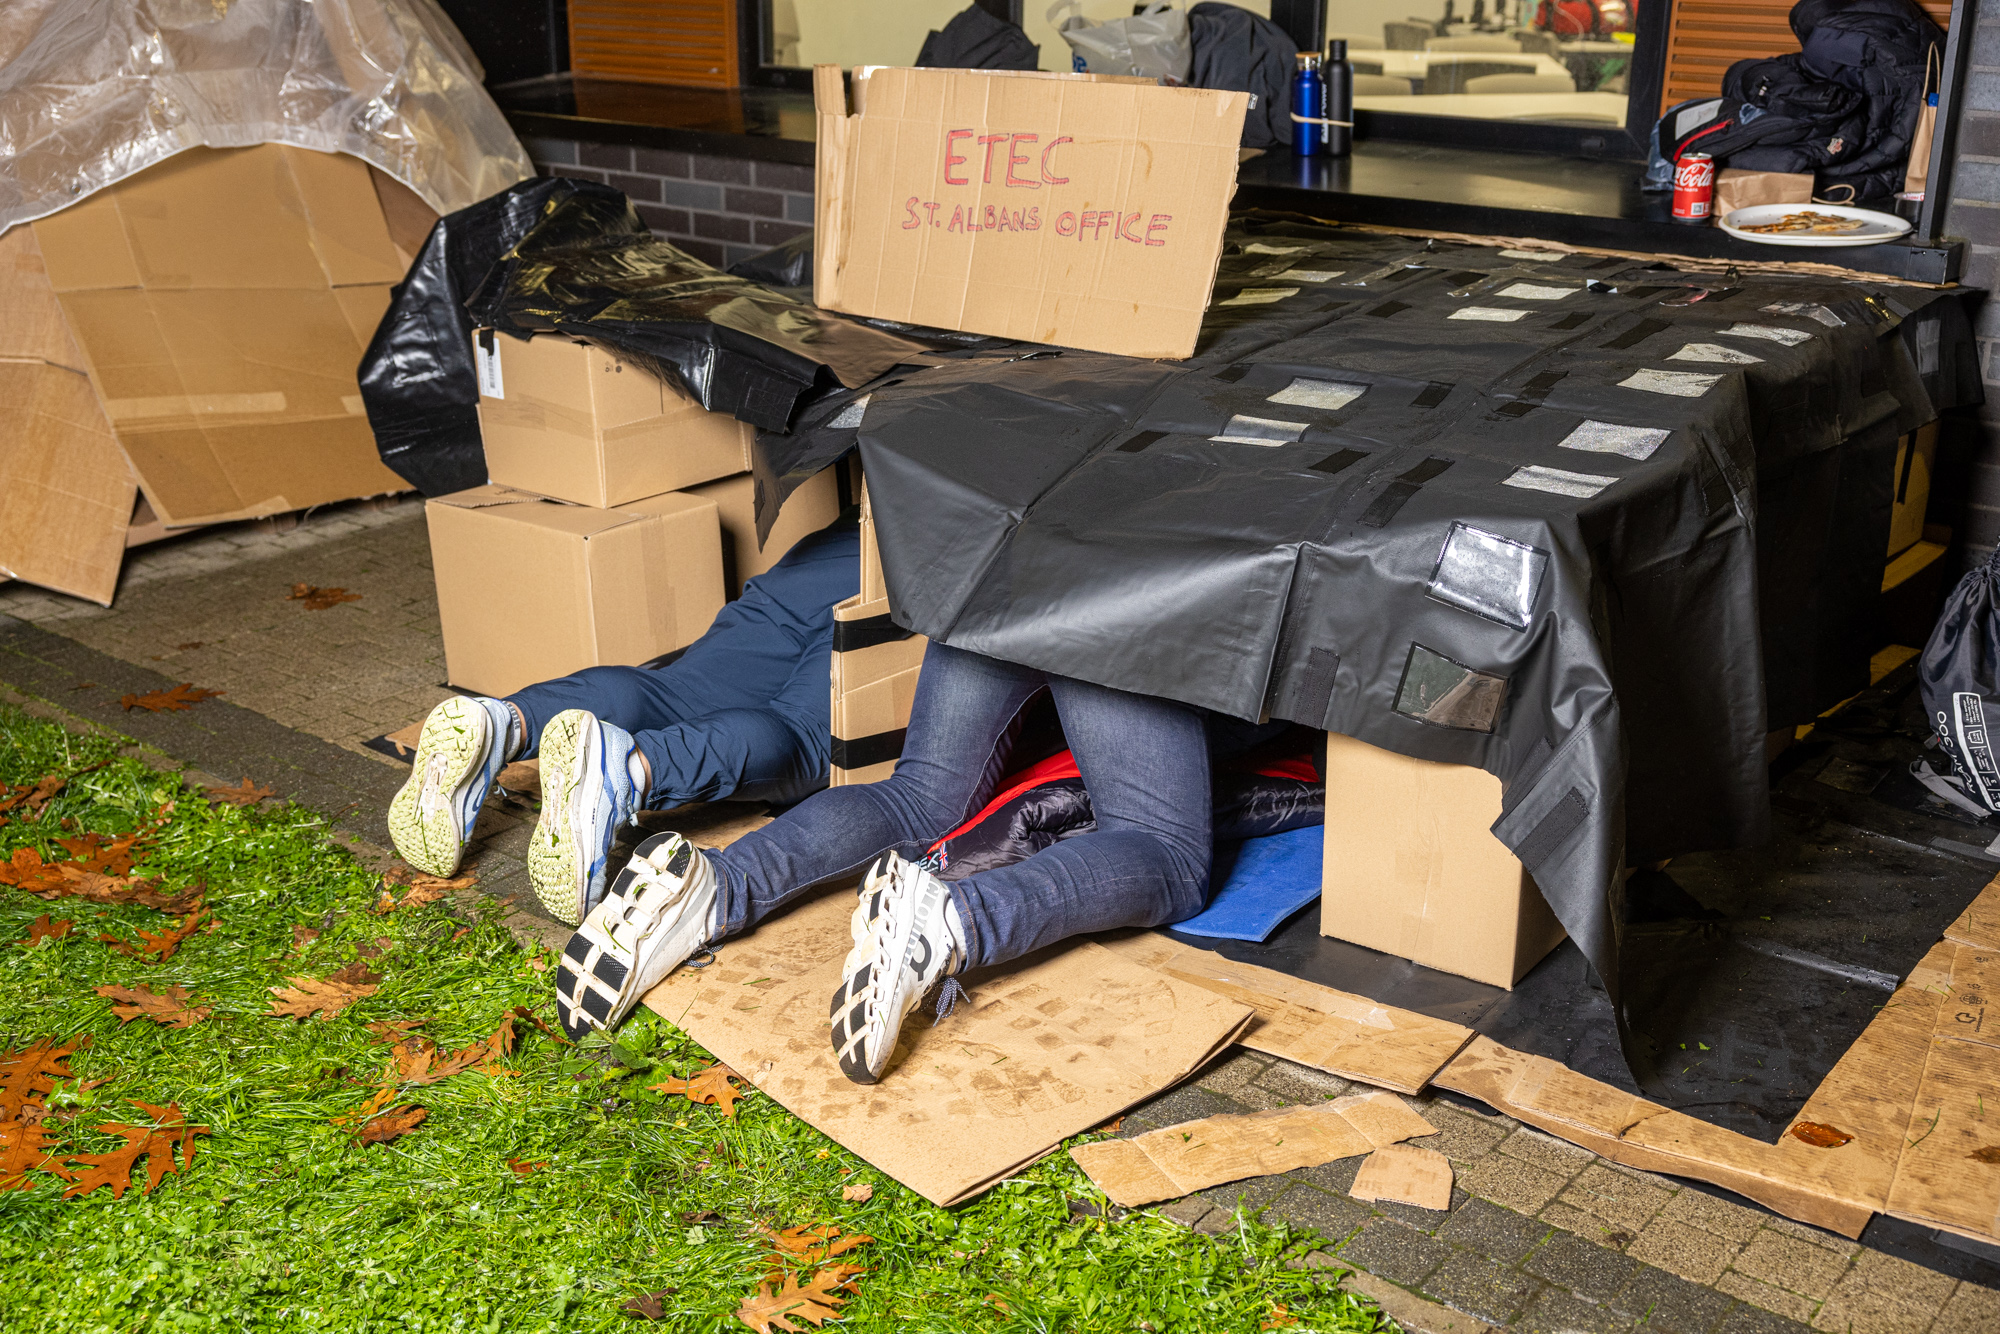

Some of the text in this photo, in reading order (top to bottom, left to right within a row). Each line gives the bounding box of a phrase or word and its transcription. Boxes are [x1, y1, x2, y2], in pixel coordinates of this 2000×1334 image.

[944, 128, 1074, 189] ETEC
[902, 197, 1173, 247] ST. ALBANS OFFICE
[1937, 711, 1976, 794] ROAM 300
